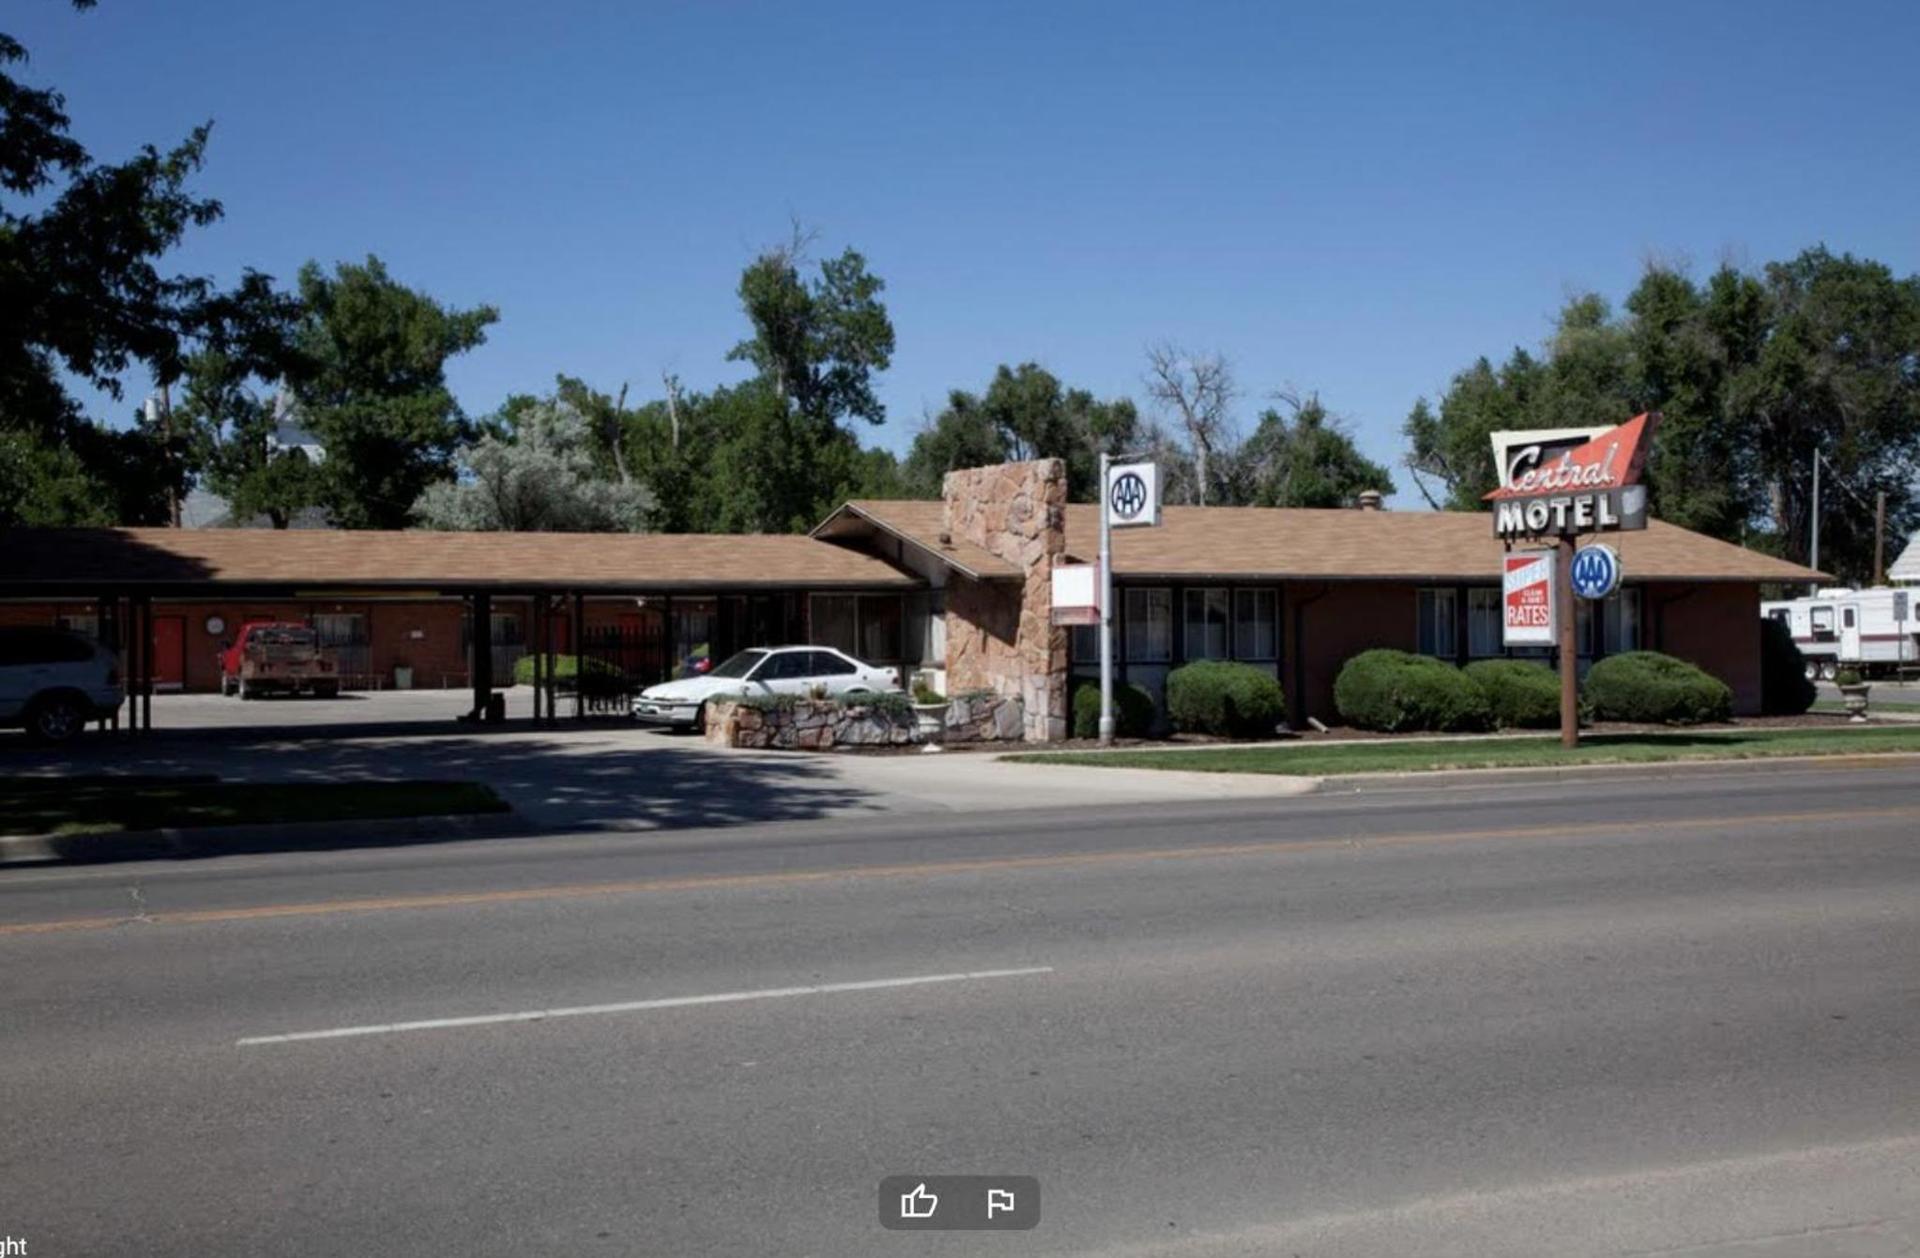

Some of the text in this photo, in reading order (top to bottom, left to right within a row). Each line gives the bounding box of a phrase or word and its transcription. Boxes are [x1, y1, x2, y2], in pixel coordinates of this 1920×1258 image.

[1508, 442, 1620, 491] Central
[1114, 475, 1143, 514] AAA
[1497, 494, 1618, 533] MOTEL
[1577, 554, 1607, 589] AAA
[1508, 605, 1548, 625] RATES
